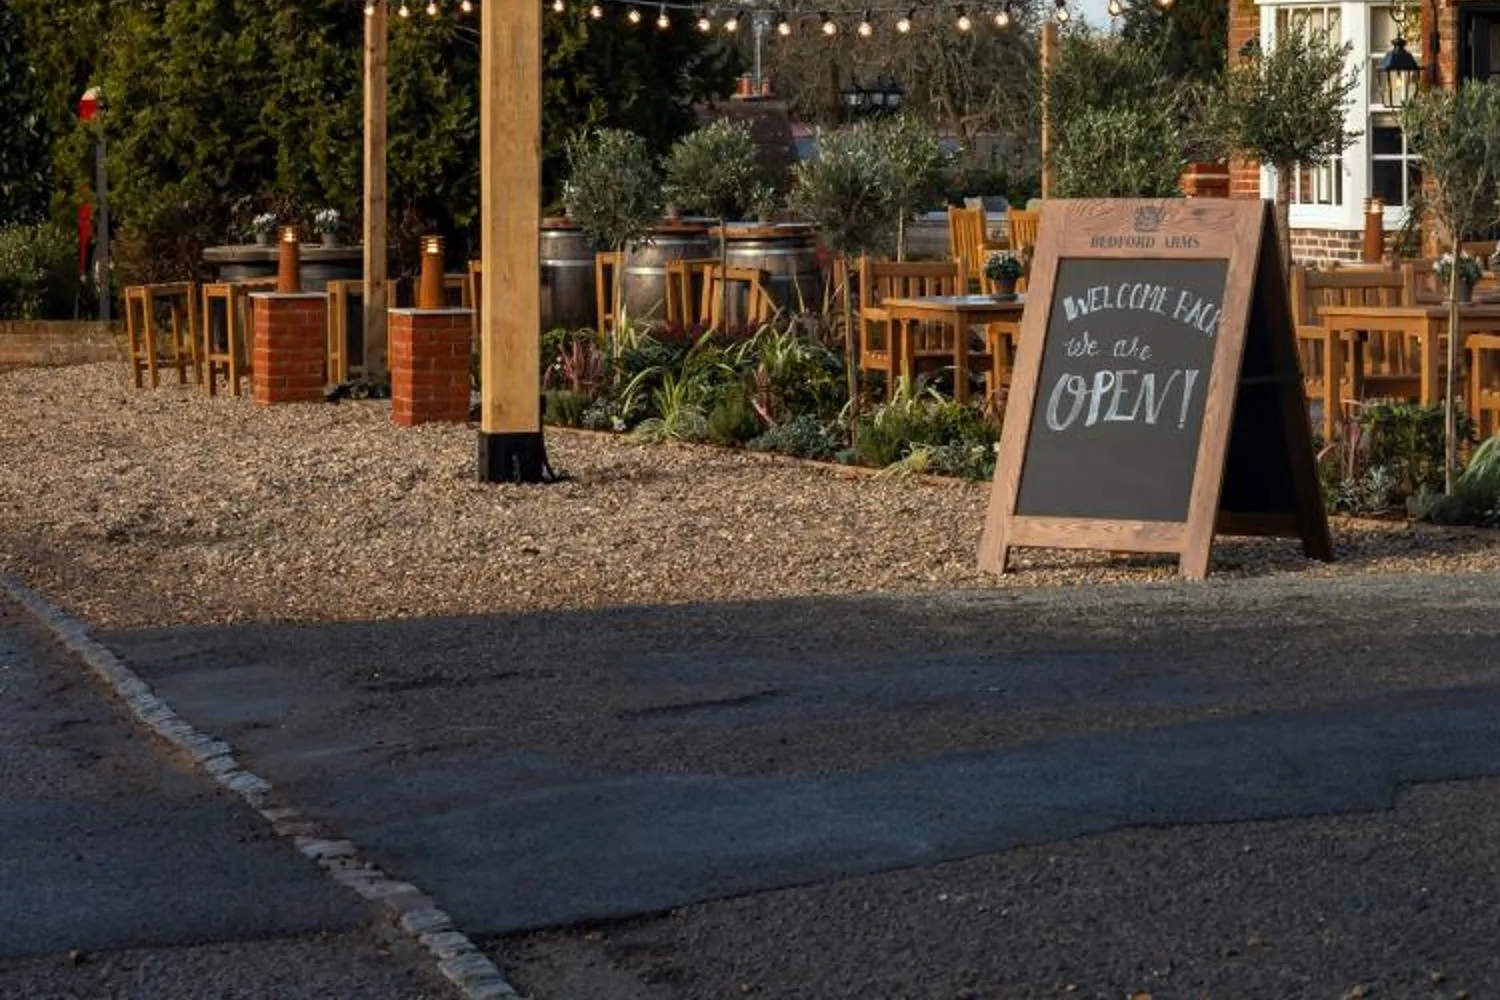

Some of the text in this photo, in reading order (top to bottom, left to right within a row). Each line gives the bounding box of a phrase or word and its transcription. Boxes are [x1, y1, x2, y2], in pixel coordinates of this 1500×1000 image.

[1089, 235, 1200, 249] BEDFORD ARMS
[1063, 283, 1173, 321] WELCOME
[1113, 336, 1153, 361] are
[1046, 369, 1199, 431] OPEN!
